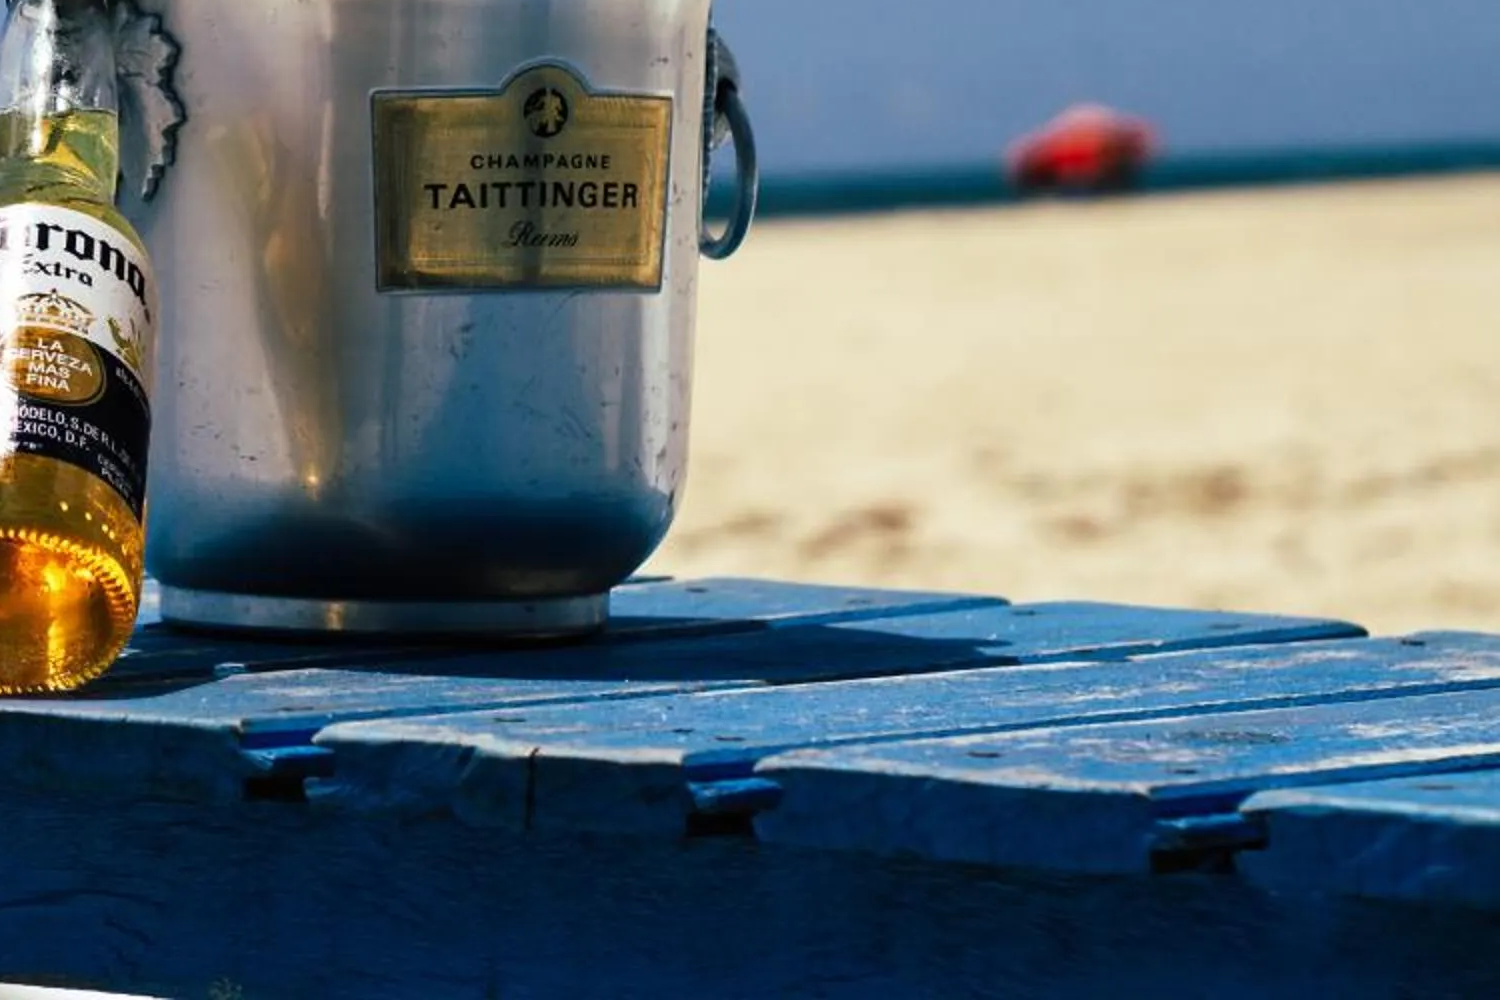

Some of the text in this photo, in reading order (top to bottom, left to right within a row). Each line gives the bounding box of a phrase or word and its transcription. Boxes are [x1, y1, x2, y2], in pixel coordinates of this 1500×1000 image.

[470, 154, 611, 170] CHAMPAGNE
[424, 181, 639, 209] TAITTINGER
[37, 337, 65, 353] LA
[28, 361, 71, 379] MAS
[25, 373, 71, 393] FINA
[9, 404, 69, 428] ODELO,
[6, 420, 61, 442] EXICO,
